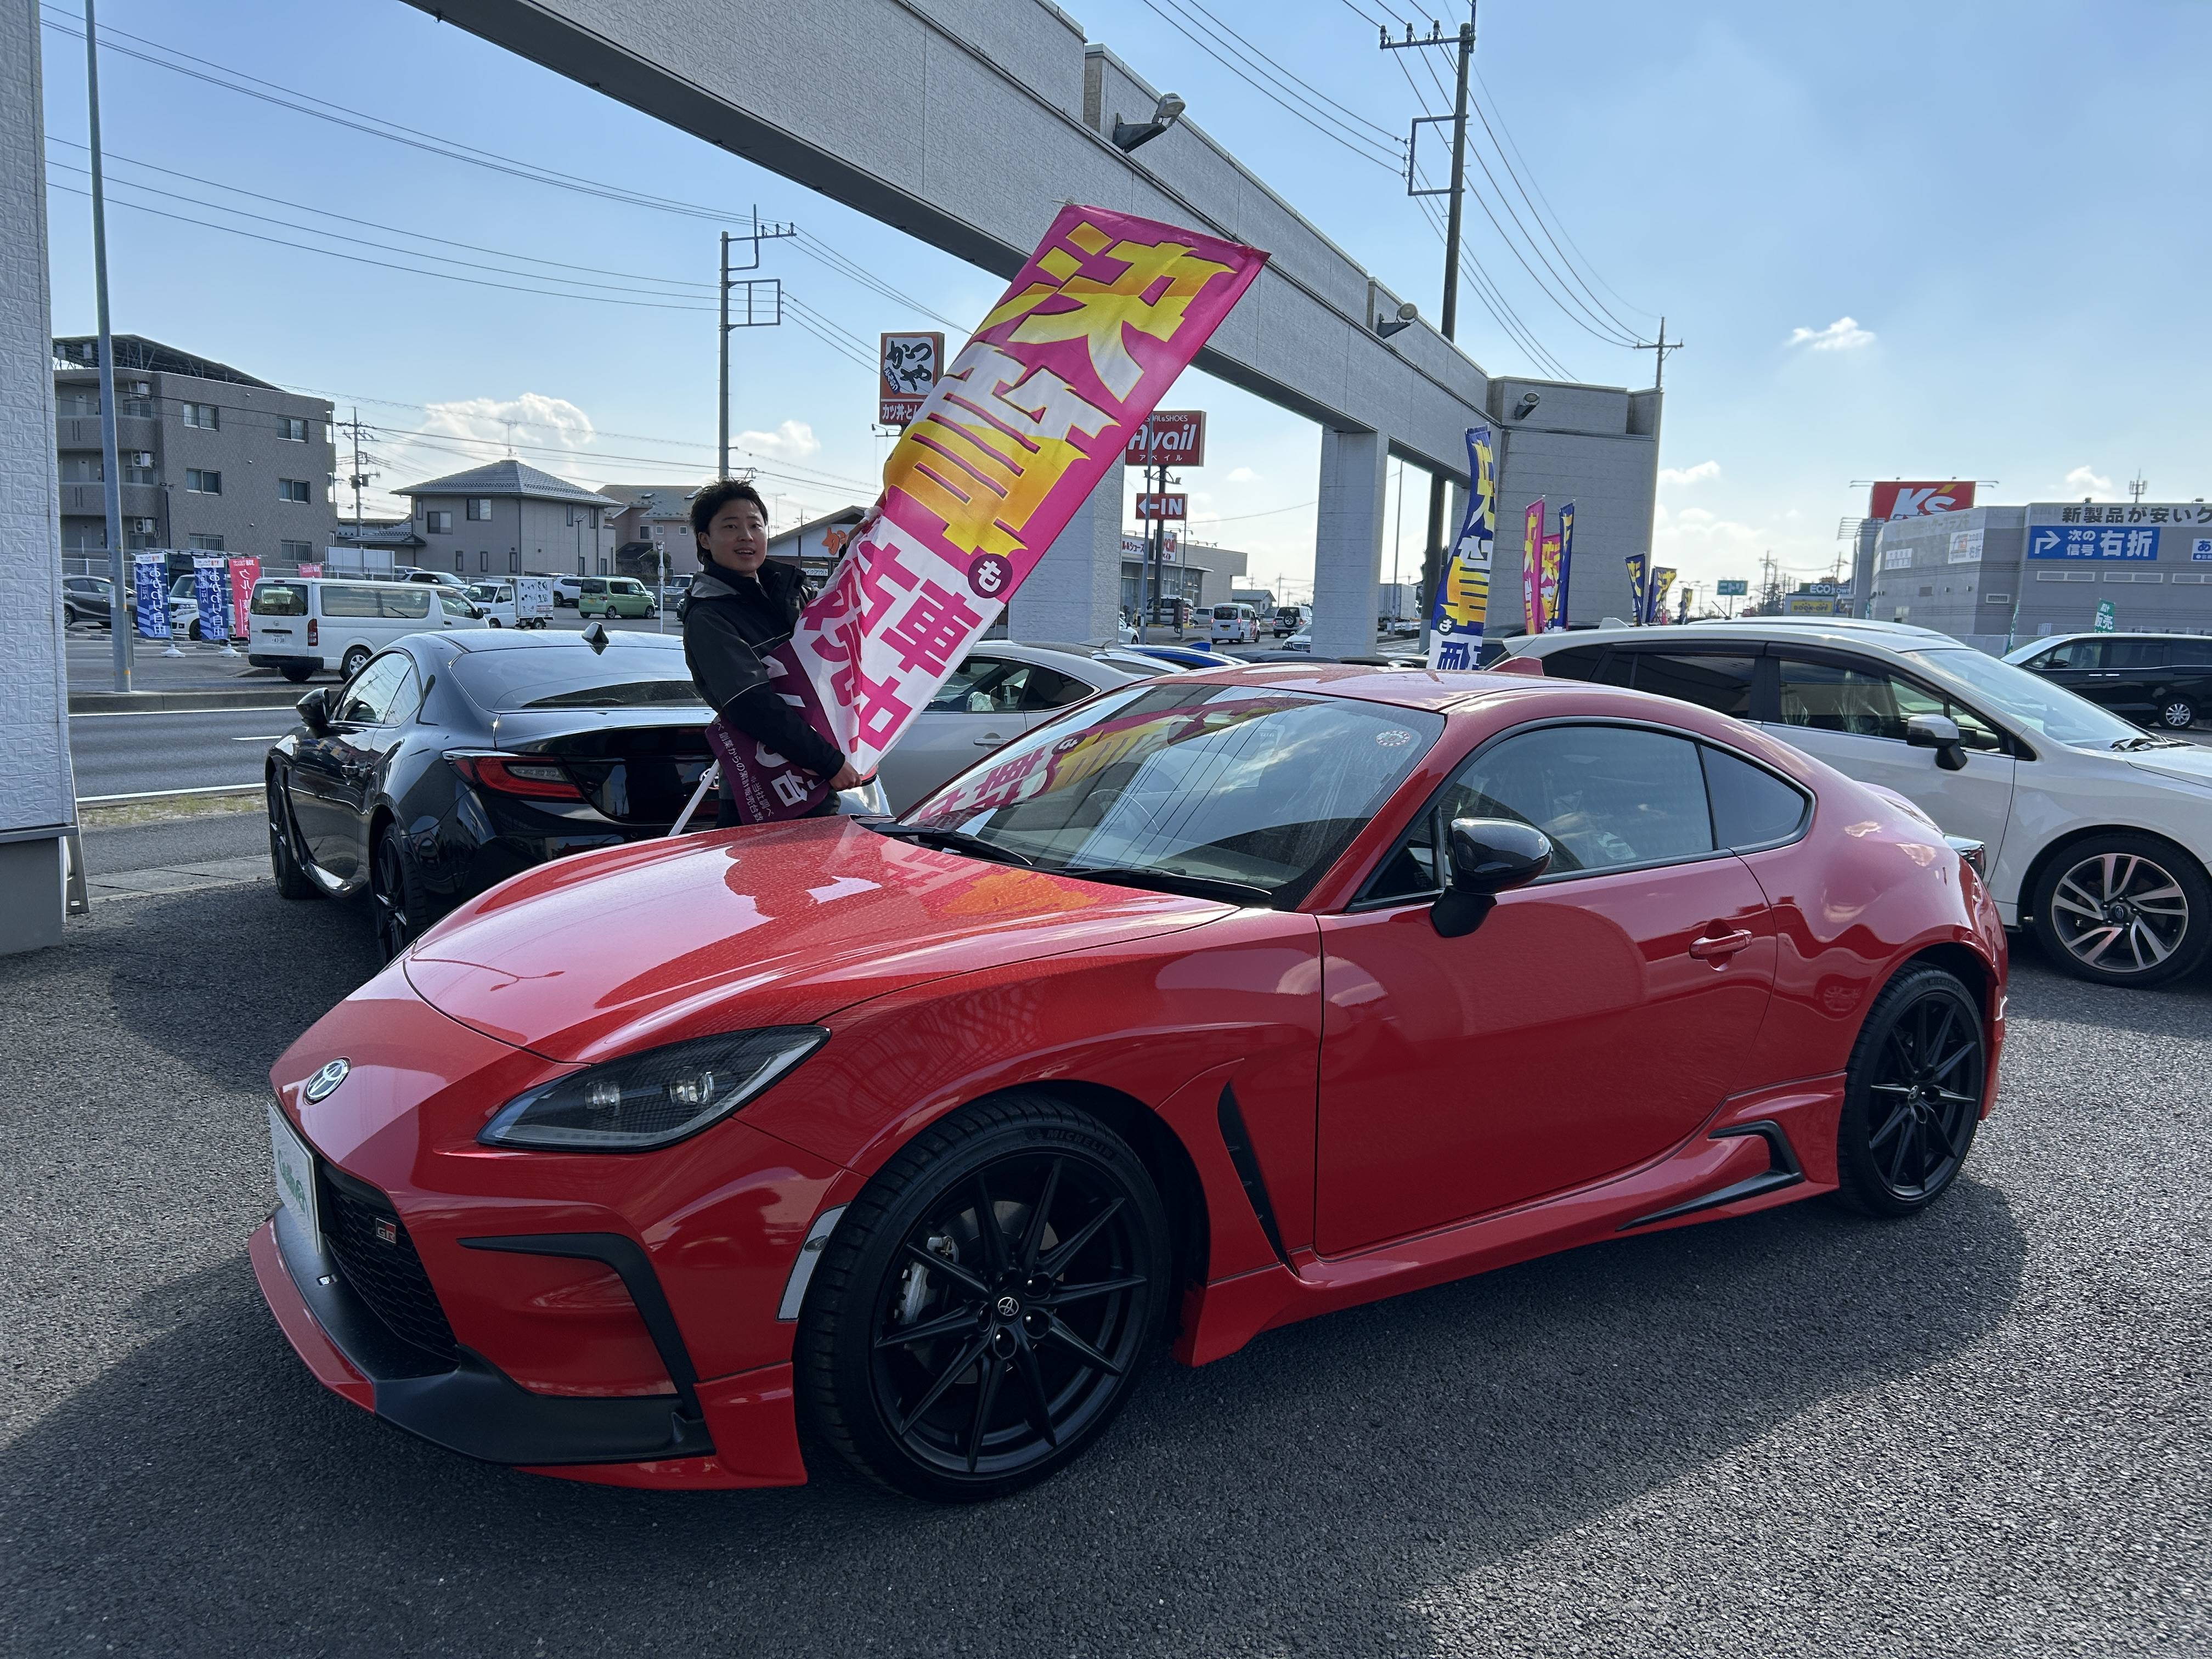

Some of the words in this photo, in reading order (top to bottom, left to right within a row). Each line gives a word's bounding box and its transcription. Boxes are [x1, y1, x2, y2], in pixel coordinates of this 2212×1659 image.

[885, 340, 932, 392] かつや
[883, 221, 1238, 556] 決算
[1128, 424, 1197, 450] Avail
[1160, 498, 1183, 515] IN
[2067, 530, 2096, 541] 次の
[2099, 529, 2153, 557] 右折
[2066, 544, 2095, 556] 信号
[977, 561, 1002, 592] も
[1718, 583, 1745, 593] ニトリ
[1809, 584, 1831, 594] ECO
[1046, 1129, 1113, 1158] MICHELIN
[377, 1226, 396, 1242] GR
